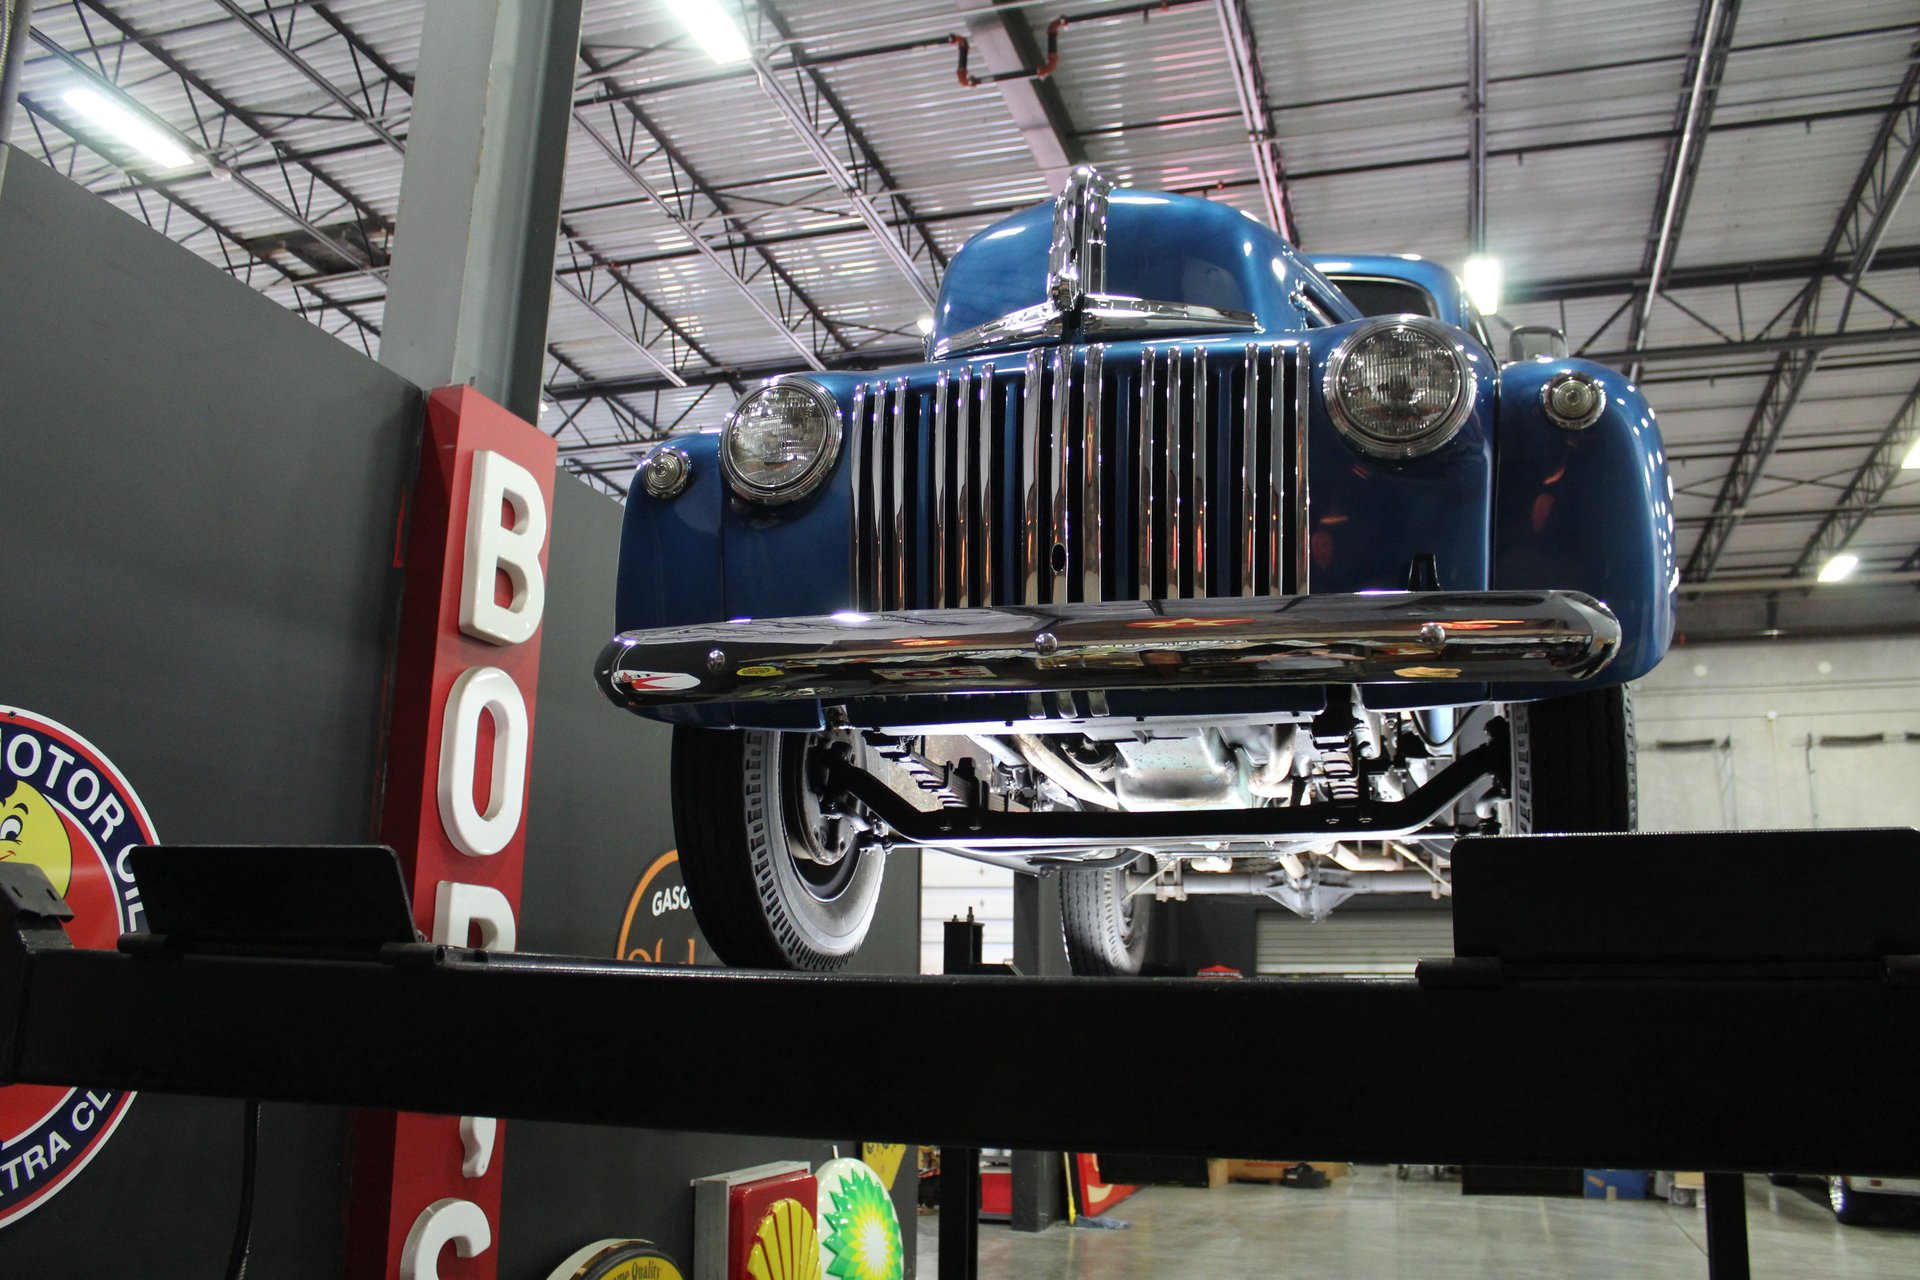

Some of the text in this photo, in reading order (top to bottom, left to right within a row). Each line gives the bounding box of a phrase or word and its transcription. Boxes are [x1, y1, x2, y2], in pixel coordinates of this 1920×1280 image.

[0, 728, 125, 842] OTOR
[652, 885, 692, 917] GASO
[0, 1130, 72, 1196] TRA
[631, 1260, 661, 1280] Quality
